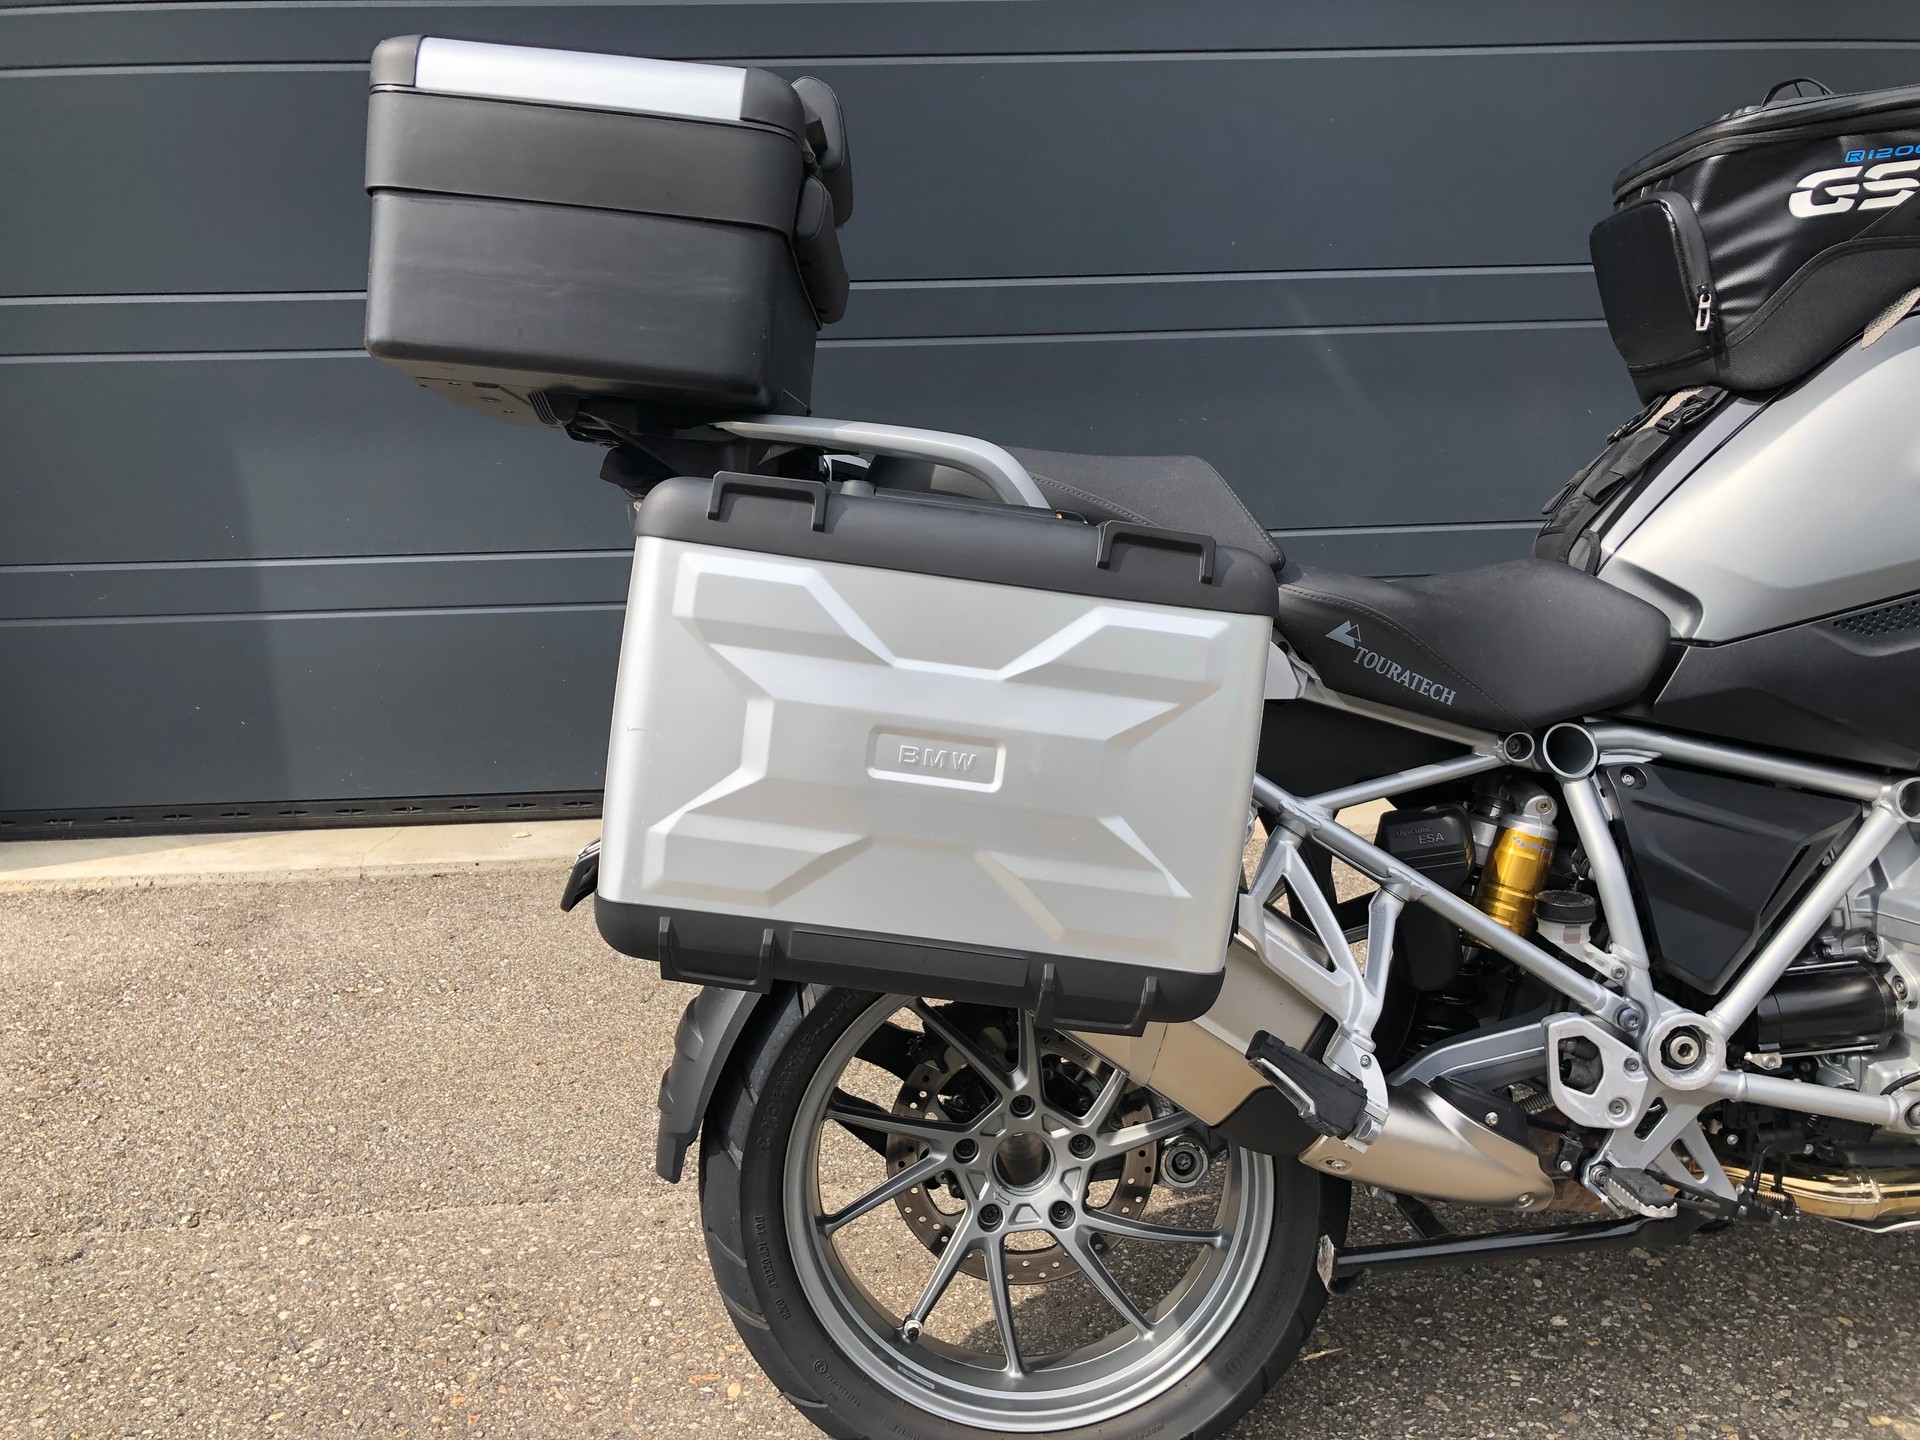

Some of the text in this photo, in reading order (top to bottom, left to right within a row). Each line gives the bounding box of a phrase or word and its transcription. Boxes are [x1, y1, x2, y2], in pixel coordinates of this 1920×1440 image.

[1844, 144, 1920, 163] R120
[1788, 159, 1920, 218] GS
[1353, 646, 1457, 706] TOURATECH
[898, 744, 977, 772] BMW
[1418, 832, 1445, 845] ESA
